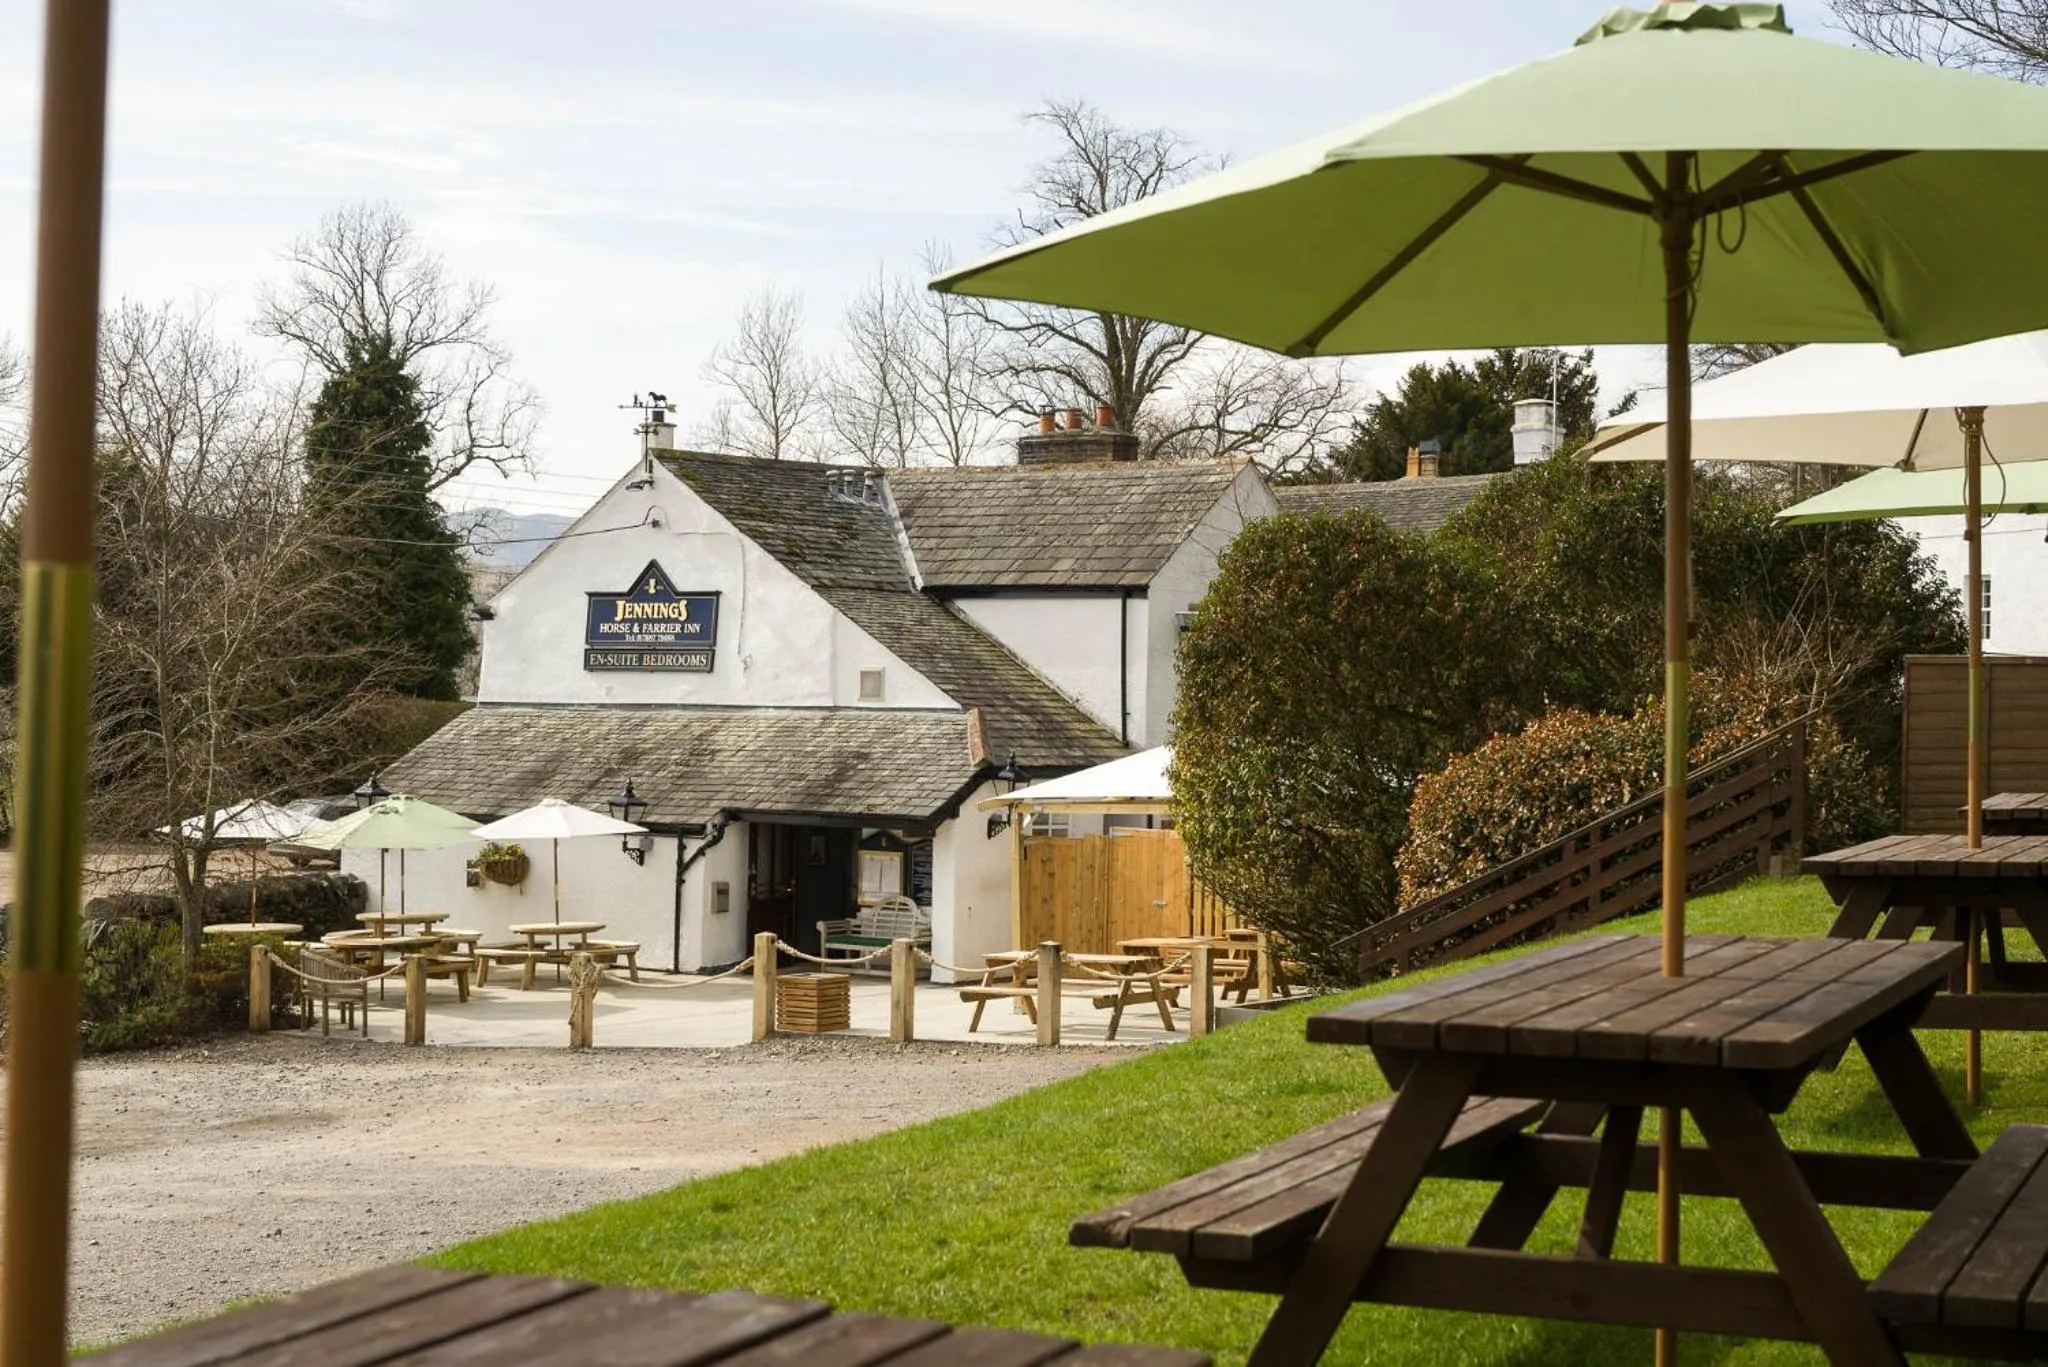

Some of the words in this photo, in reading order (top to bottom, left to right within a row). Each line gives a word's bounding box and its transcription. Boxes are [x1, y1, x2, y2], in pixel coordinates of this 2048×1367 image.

[614, 599, 688, 622] JENNINGS
[600, 623, 631, 633] HORSE
[632, 623, 640, 633] &
[642, 623, 682, 633] FARRIER
[684, 623, 701, 633] INN
[589, 653, 639, 666] EN-SUITE
[642, 653, 707, 666] BEDROOMS
